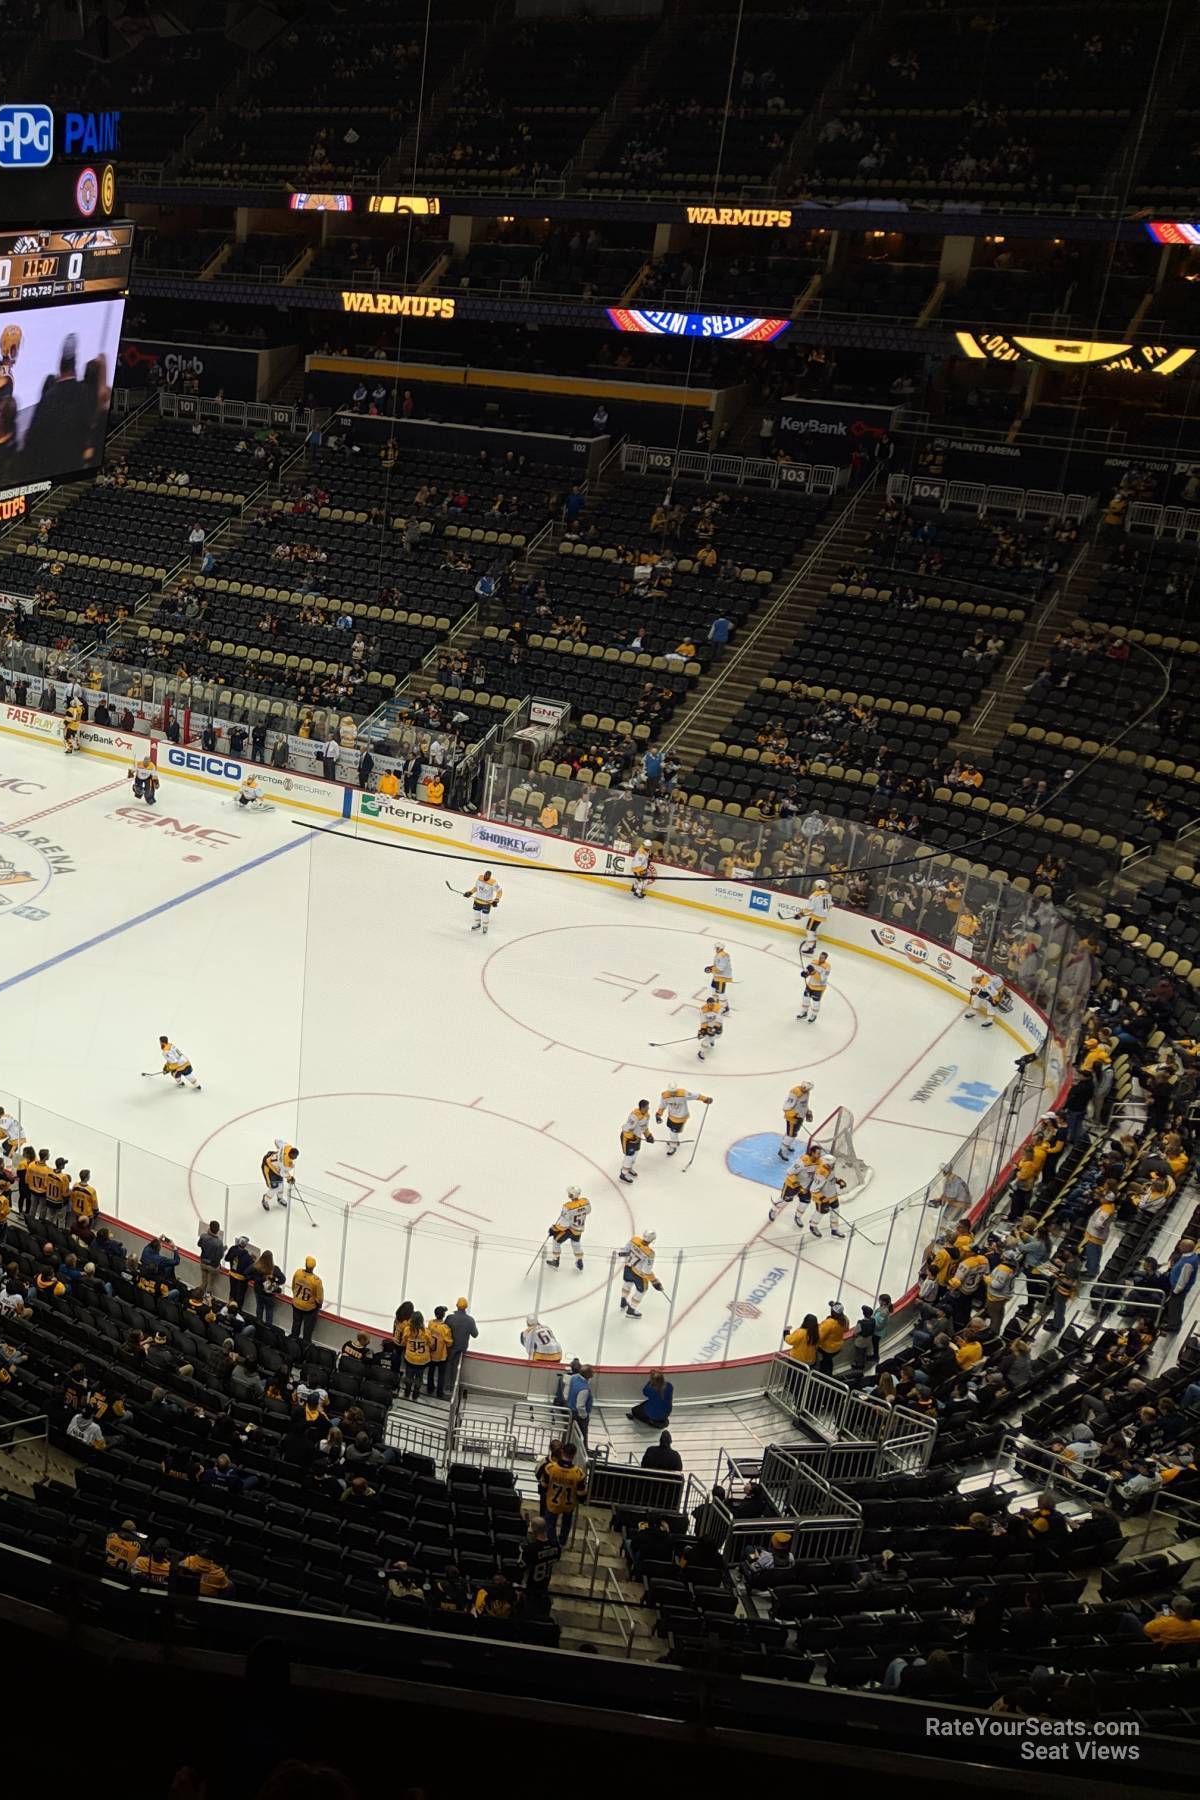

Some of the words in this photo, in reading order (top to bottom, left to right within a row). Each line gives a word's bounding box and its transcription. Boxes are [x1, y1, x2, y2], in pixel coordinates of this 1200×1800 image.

[65, 111, 120, 154] PAINT
[687, 207, 792, 227] WARMUPS
[25, 258, 56, 277] 11:07
[67, 252, 83, 280] 0
[22, 286, 52, 298] $13,725
[341, 291, 455, 318] WARMUPS
[180, 401, 194, 412] 101
[274, 411, 289, 423] 101
[340, 417, 352, 425] 102
[780, 416, 848, 436] KeyBank
[573, 443, 587, 453] 102
[952, 440, 985, 454] PAINTS
[986, 445, 1021, 457] ARENA
[650, 454, 672, 467] 103
[1105, 458, 1131, 468] HOME
[781, 469, 805, 482] 103
[19, 480, 52, 496] ELECTRIC
[914, 484, 941, 498] 104
[532, 707, 562, 719] GNC
[79, 730, 114, 746] KeyBank
[168, 748, 242, 780] GEICO
[252, 774, 283, 786] VECTOR
[294, 782, 332, 797] SECURITY
[367, 798, 454, 830] enterprise
[115, 807, 241, 845] GNC
[479, 831, 528, 850] SHORKEY
[8, 828, 77, 875] ARENA
[605, 853, 626, 873] IC
[752, 895, 769, 906] IGS
[777, 902, 801, 913] IGS.CO
[879, 930, 897, 942] Gulf
[903, 943, 927, 959] Gulf
[937, 956, 953, 968] Gulf
[1022, 1011, 1046, 1045] Walma
[910, 1065, 951, 1104] HIGHMARK
[295, 1283, 312, 1301] 76
[746, 1267, 789, 1305] VECTOR
[551, 1484, 572, 1505] 71
